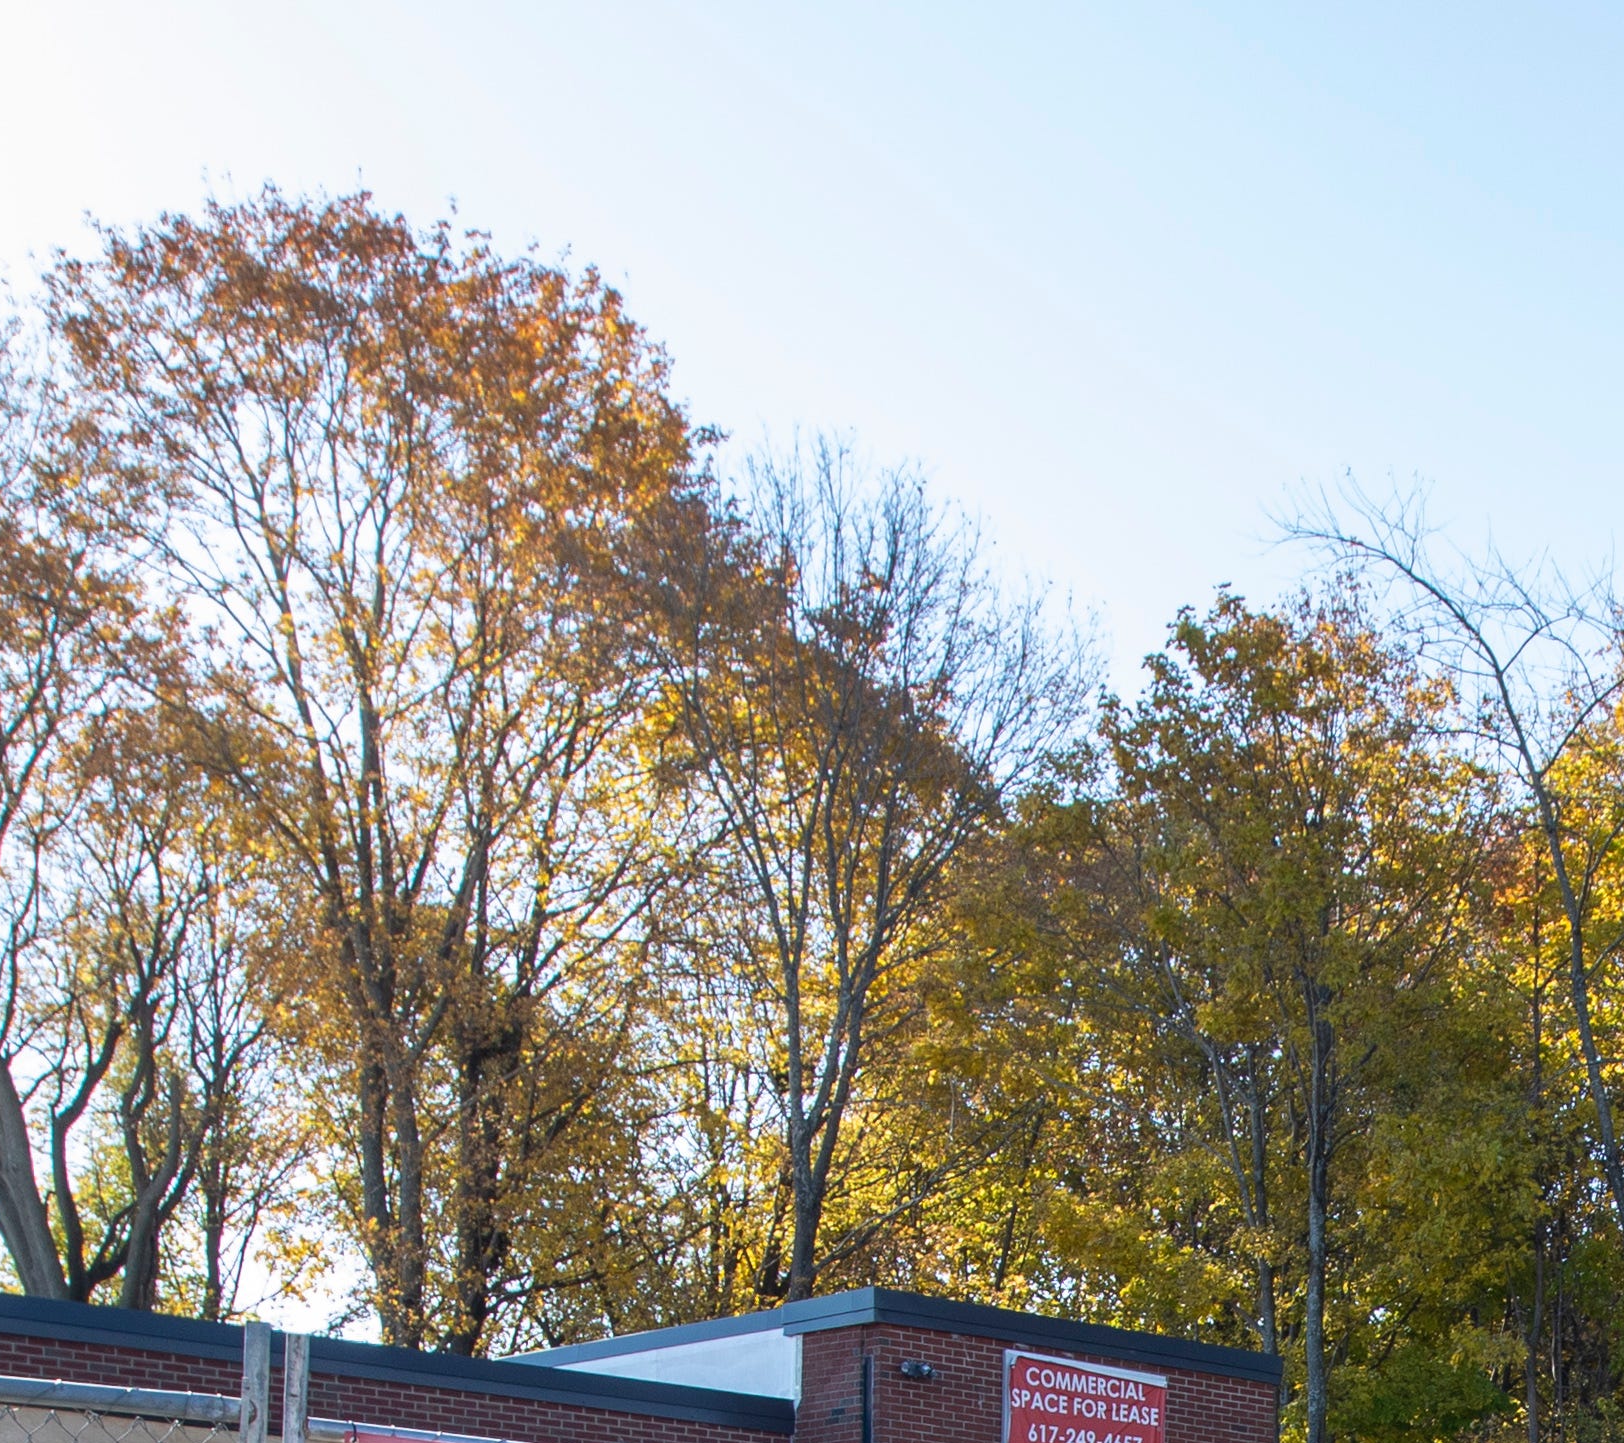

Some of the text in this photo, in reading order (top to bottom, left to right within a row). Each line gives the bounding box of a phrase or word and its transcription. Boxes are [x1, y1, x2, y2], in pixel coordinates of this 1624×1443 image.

[1026, 1367, 1146, 1401] COMMERCIAL
[1011, 1388, 1159, 1426] SPACE FOR LEASE
